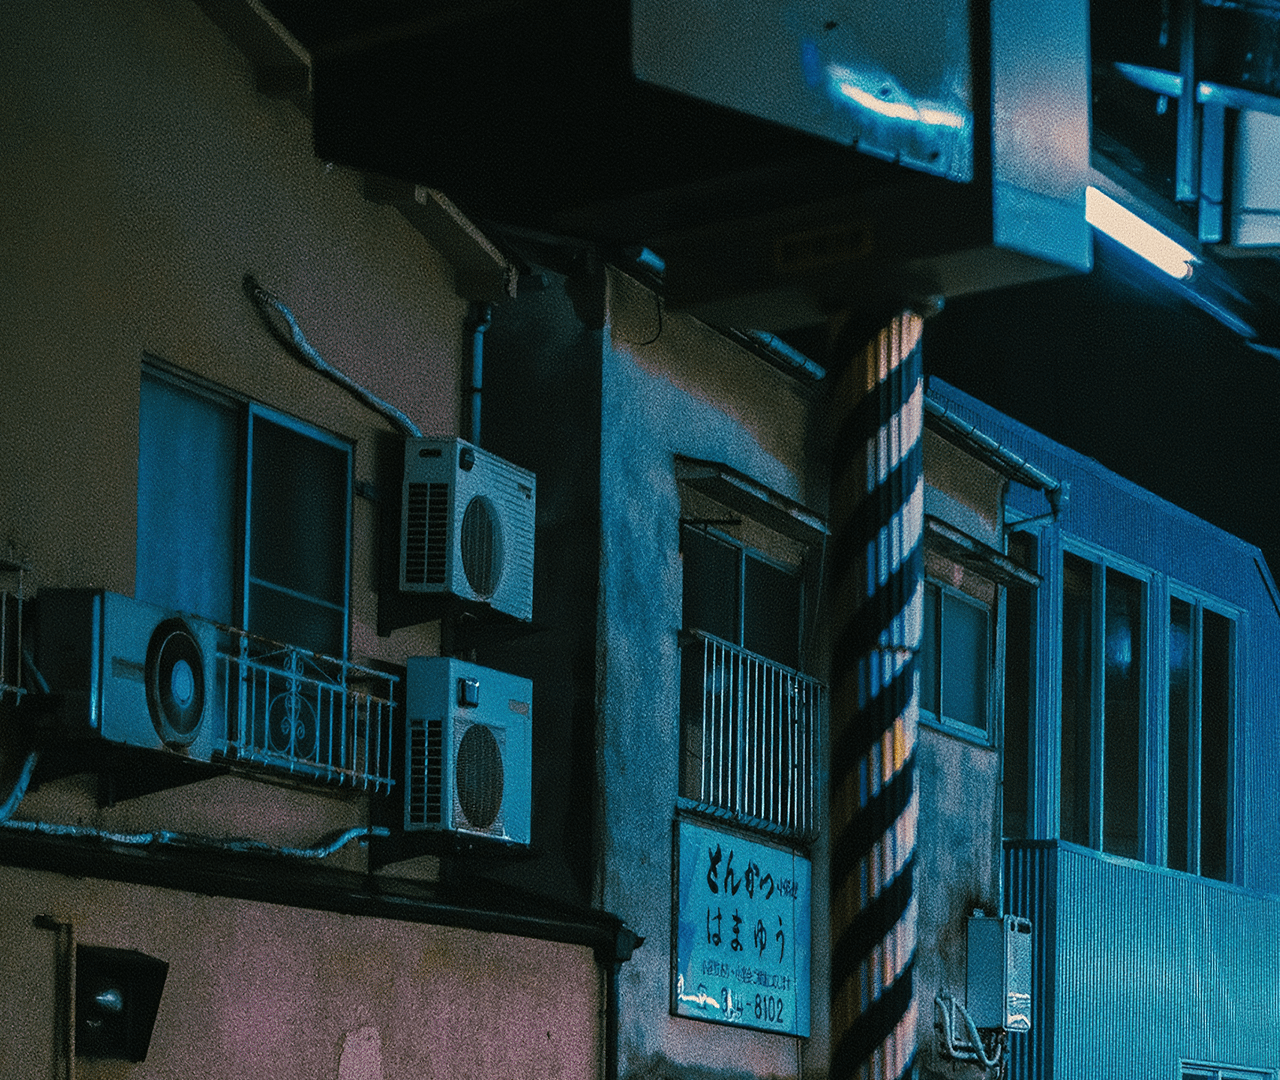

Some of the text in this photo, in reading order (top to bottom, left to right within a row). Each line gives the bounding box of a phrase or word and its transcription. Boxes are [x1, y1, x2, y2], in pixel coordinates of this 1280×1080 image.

[707, 843, 774, 900] とんかつ
[706, 907, 786, 964] はまゆう
